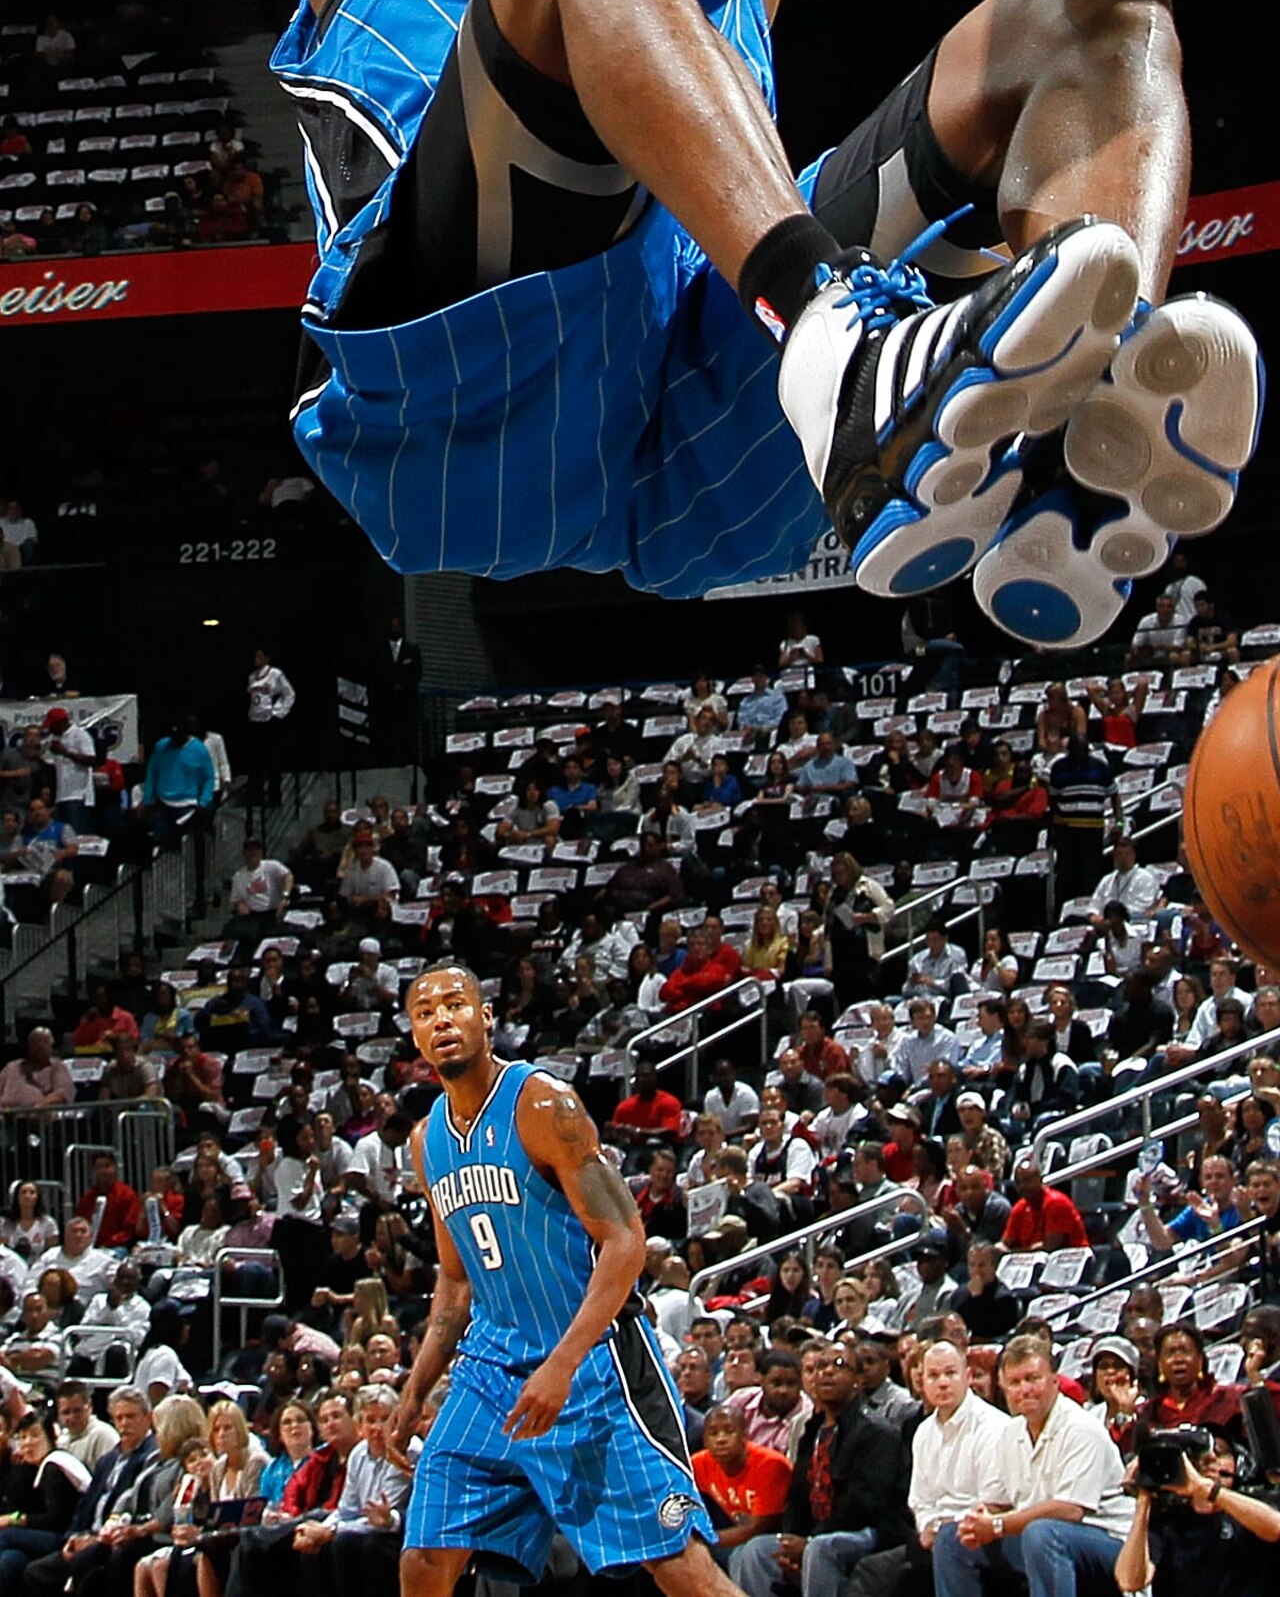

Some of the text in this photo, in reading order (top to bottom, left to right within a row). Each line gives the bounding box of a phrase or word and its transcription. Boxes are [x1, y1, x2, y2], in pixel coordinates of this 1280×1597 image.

[179, 538, 277, 564] 221-222
[858, 672, 896, 697] 101
[431, 1164, 520, 1221] ORLANDO
[469, 1213, 504, 1271] 9
